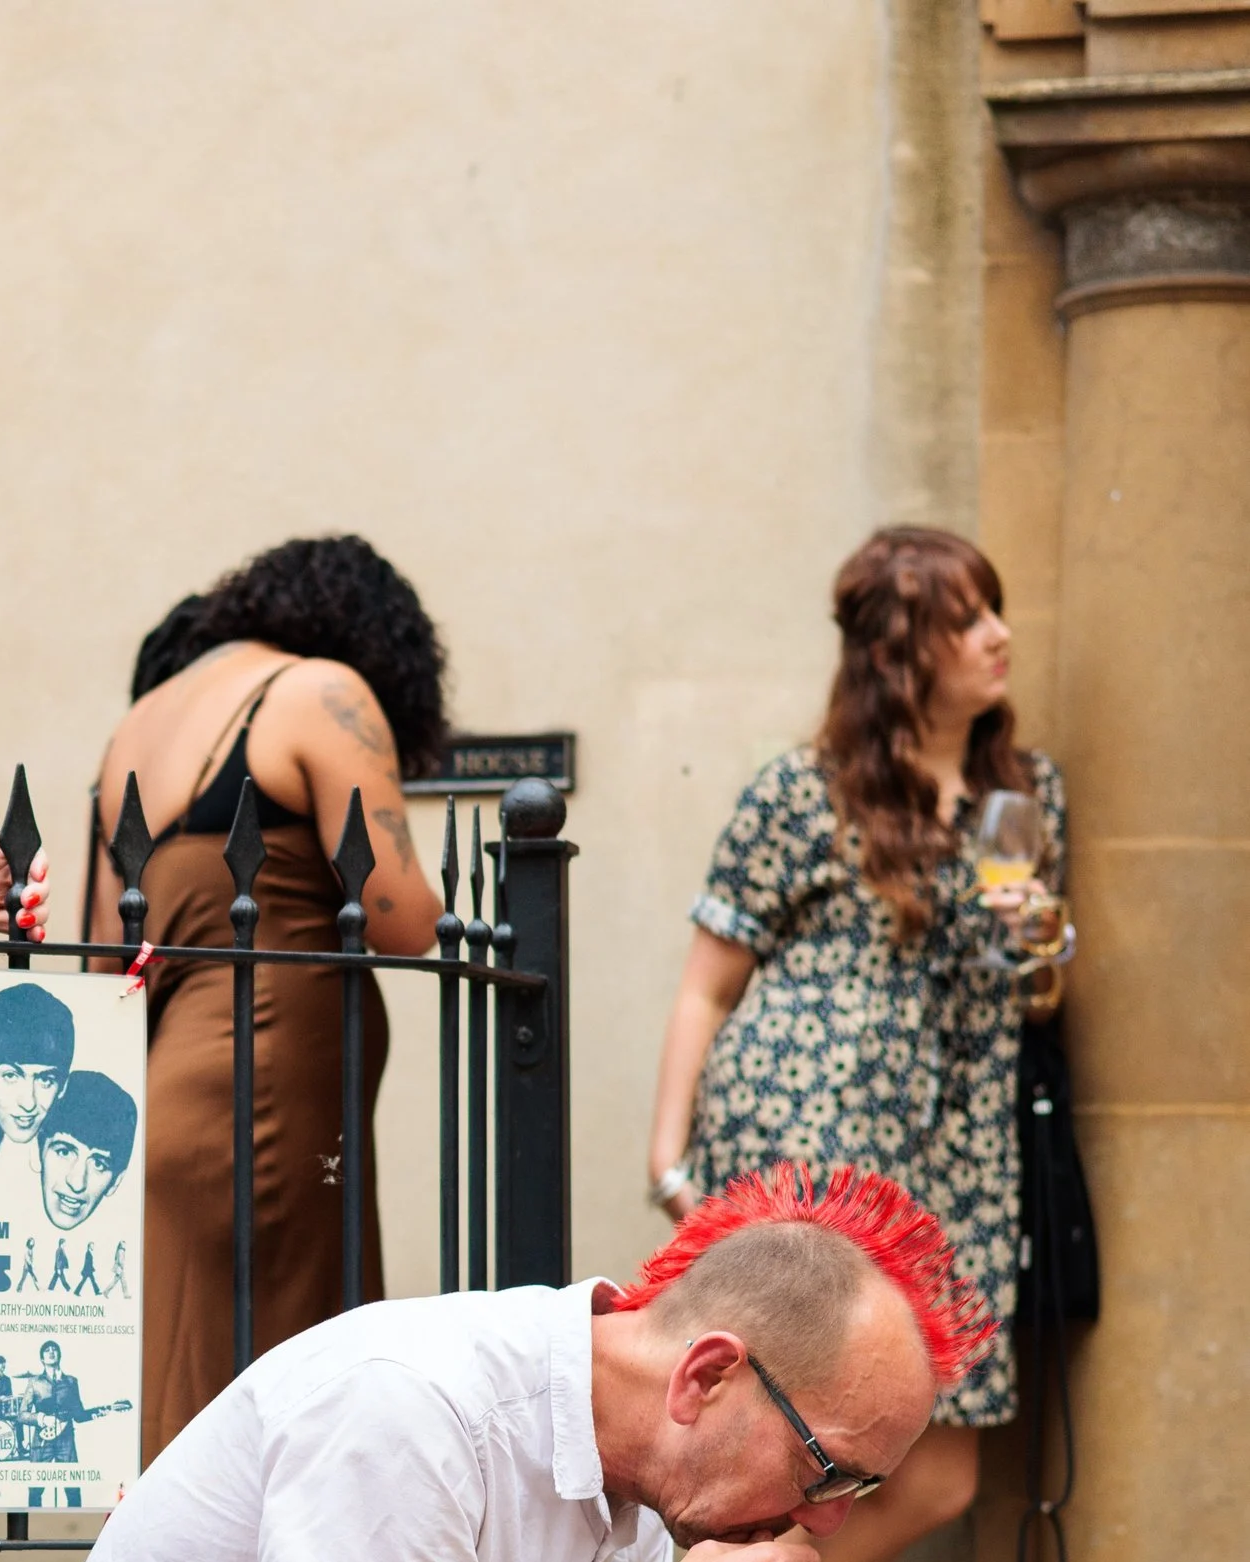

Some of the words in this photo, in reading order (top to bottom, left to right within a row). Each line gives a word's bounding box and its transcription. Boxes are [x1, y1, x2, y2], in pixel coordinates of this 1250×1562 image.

[20, 1323, 59, 1334] REIMAGINING
[59, 1324, 78, 1334] THESE
[78, 1324, 105, 1334] TIMELESS
[0, 1469, 8, 1481] ST
[36, 1469, 67, 1482] SQUARE
[69, 1470, 86, 1482] NN1
